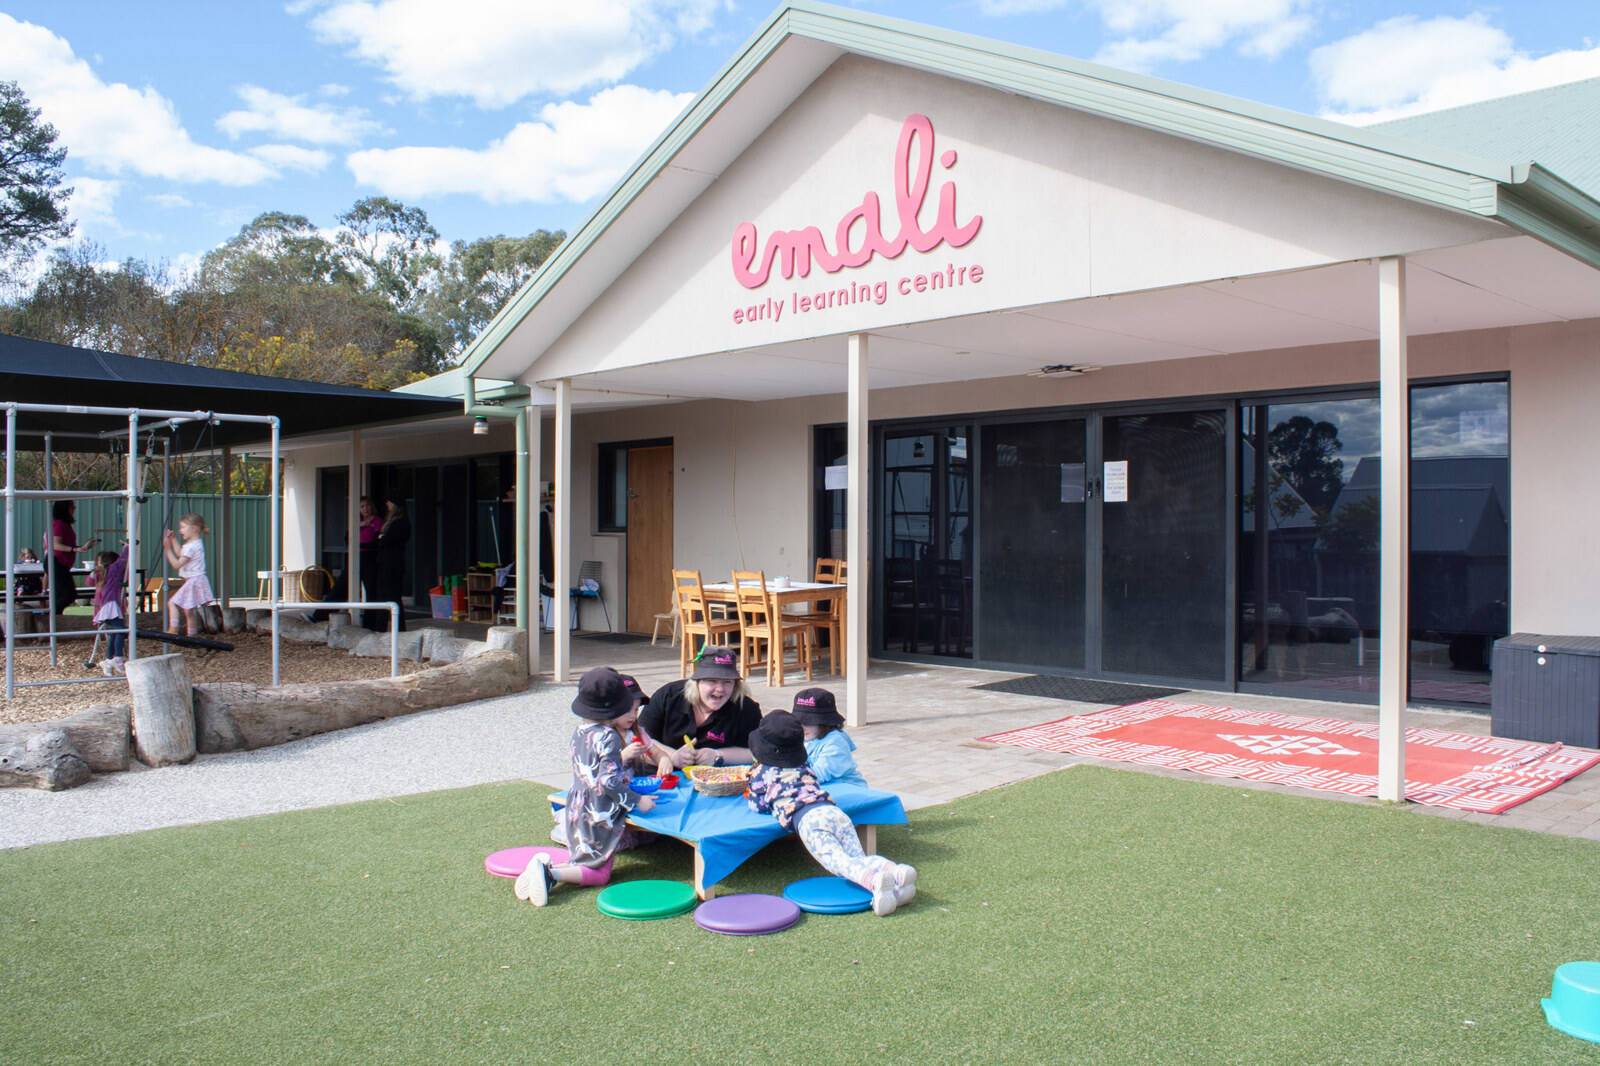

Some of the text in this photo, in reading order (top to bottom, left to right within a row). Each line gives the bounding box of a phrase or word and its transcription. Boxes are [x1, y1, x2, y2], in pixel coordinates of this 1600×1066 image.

[731, 112, 983, 289] emali
[732, 263, 984, 324] early learning centre
